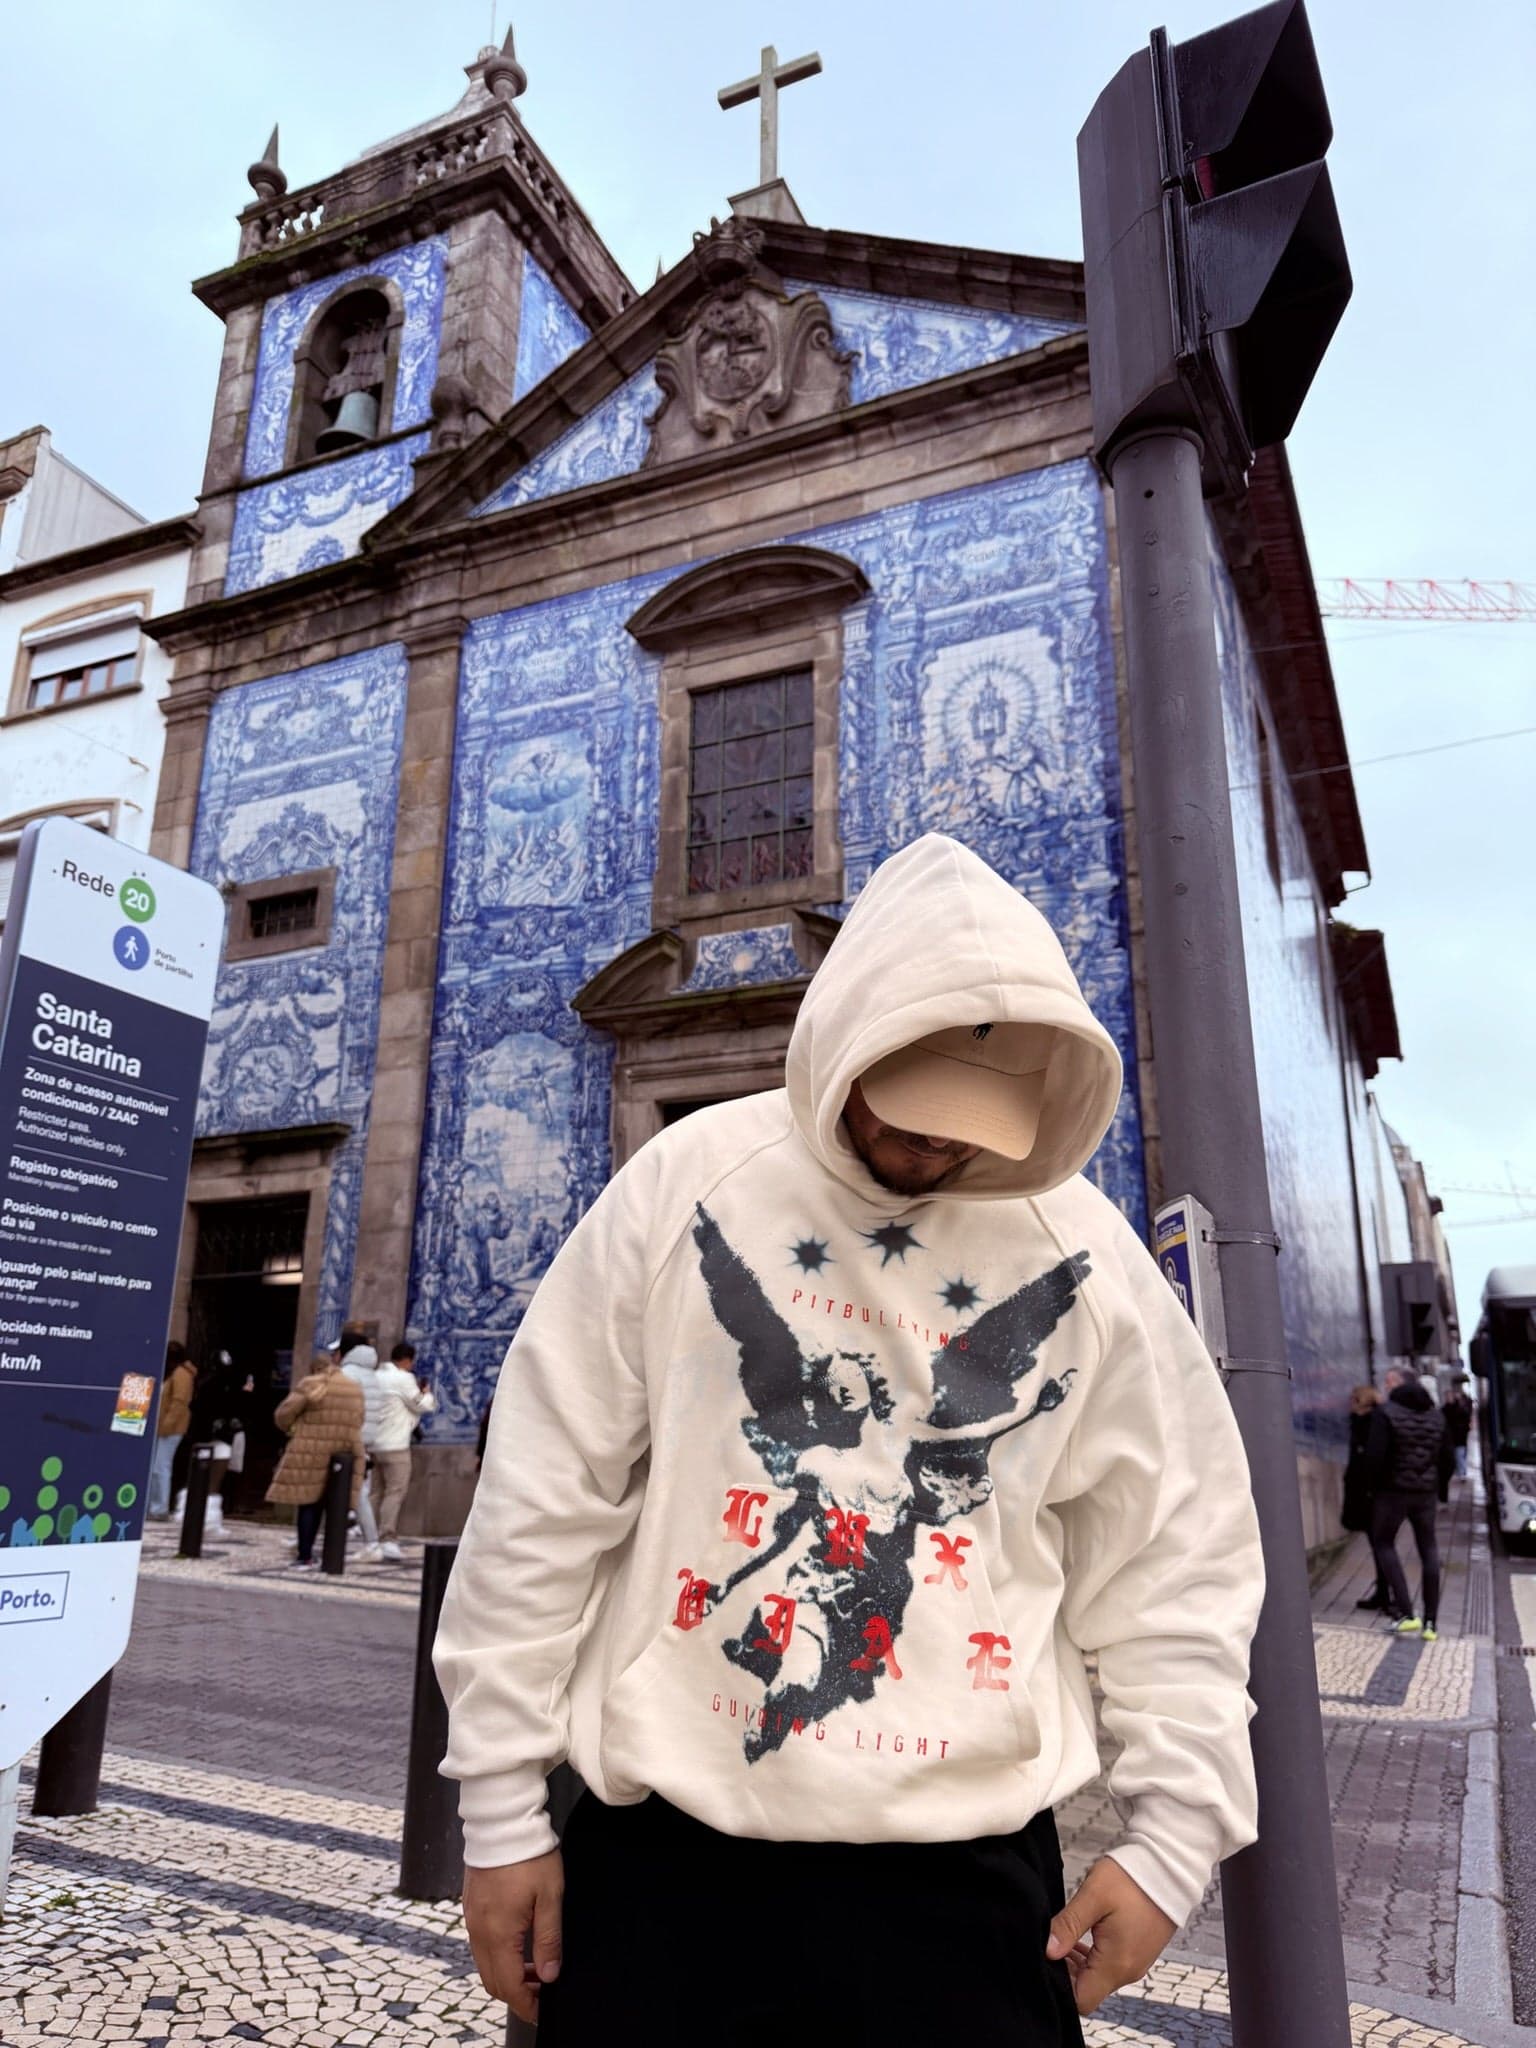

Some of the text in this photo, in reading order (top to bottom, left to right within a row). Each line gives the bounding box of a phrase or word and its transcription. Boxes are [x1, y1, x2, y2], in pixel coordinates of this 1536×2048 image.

[62, 859, 150, 912] Rede 20
[36, 992, 113, 1039] Santa
[32, 1023, 142, 1078] Catarina
[21, 1087, 139, 1126] condicionado / ZAAC
[24, 1066, 169, 1117] Zona de acesso automóvel
[15, 1120, 67, 1142] Authorized
[69, 1134, 105, 1151] vehicles
[18, 1105, 92, 1133] Restricted area.
[10, 1155, 118, 1189] Registro obrigatório
[1, 1214, 36, 1231] da via
[3, 1198, 158, 1237] Posicione o veículo no centro
[43, 1265, 69, 1279] pelo
[70, 1268, 97, 1282] sinal
[98, 1274, 127, 1287] verde
[128, 1279, 152, 1291] para
[49, 1325, 93, 1340] máxima
[792, 1289, 969, 1351] PITBULLYING
[1, 1352, 41, 1371] km/h
[0, 1589, 55, 1611] Porto.
[712, 1693, 950, 1760] GUIDING LIGHT
